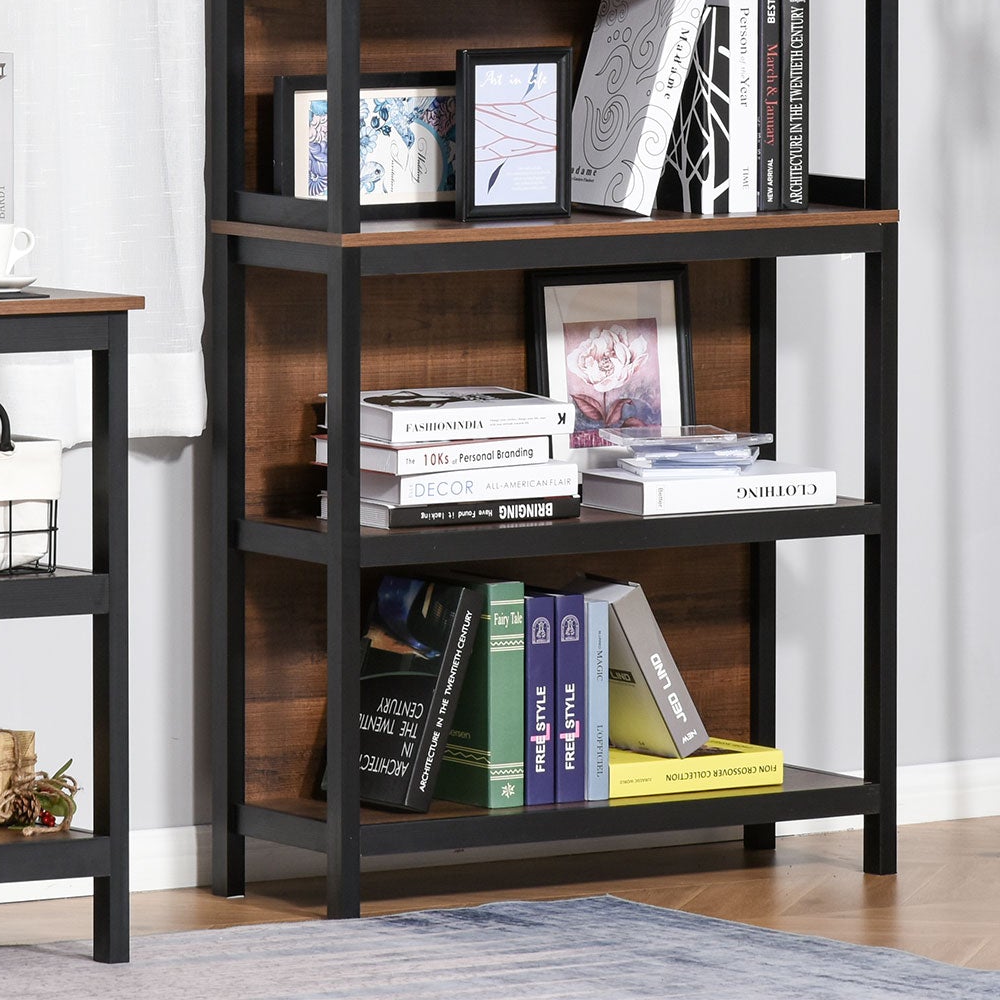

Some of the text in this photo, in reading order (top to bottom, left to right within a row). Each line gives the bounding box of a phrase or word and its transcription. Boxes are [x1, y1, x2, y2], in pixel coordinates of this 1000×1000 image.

[740, 8, 750, 56] Person
[789, 6, 804, 49] CENTURY
[664, 27, 690, 100] Madame
[480, 70, 502, 88] Art
[509, 75, 522, 86] in
[789, 49, 803, 104] TWENTIETH
[740, 77, 750, 107] Year
[764, 44, 779, 147] March & January
[789, 107, 803, 128] THE
[789, 128, 803, 140] IN
[742, 168, 750, 189] TIME
[766, 157, 774, 203] NEW ARRIVAL
[557, 412, 567, 425] K
[405, 457, 416, 465] The
[424, 452, 450, 466] 10Ks
[459, 450, 495, 463] Personal
[496, 447, 534, 460] Branding
[414, 477, 572, 498] DECOR ALL-AMERICAN FLAIR
[736, 483, 818, 500] CLOTHING
[420, 511, 445, 520] lacking
[457, 510, 476, 519] Found
[478, 509, 493, 517] Have
[499, 502, 554, 520] BRINGING
[494, 611, 523, 629] Fairy Tale
[377, 697, 424, 720] CENTURY
[418, 609, 473, 793] ARCHITECTURE IN THE TWENTIETH CENTURY
[650, 653, 698, 745] NEW JED LIND
[359, 711, 418, 739] THE TWENTI
[535, 685, 547, 773] FREE STYLE
[565, 683, 576, 770] FREE STYLE
[400, 740, 414, 759] IN
[359, 753, 410, 777] ARCHITEC
[665, 764, 777, 782] FION CROSSOVER COLLECTION
